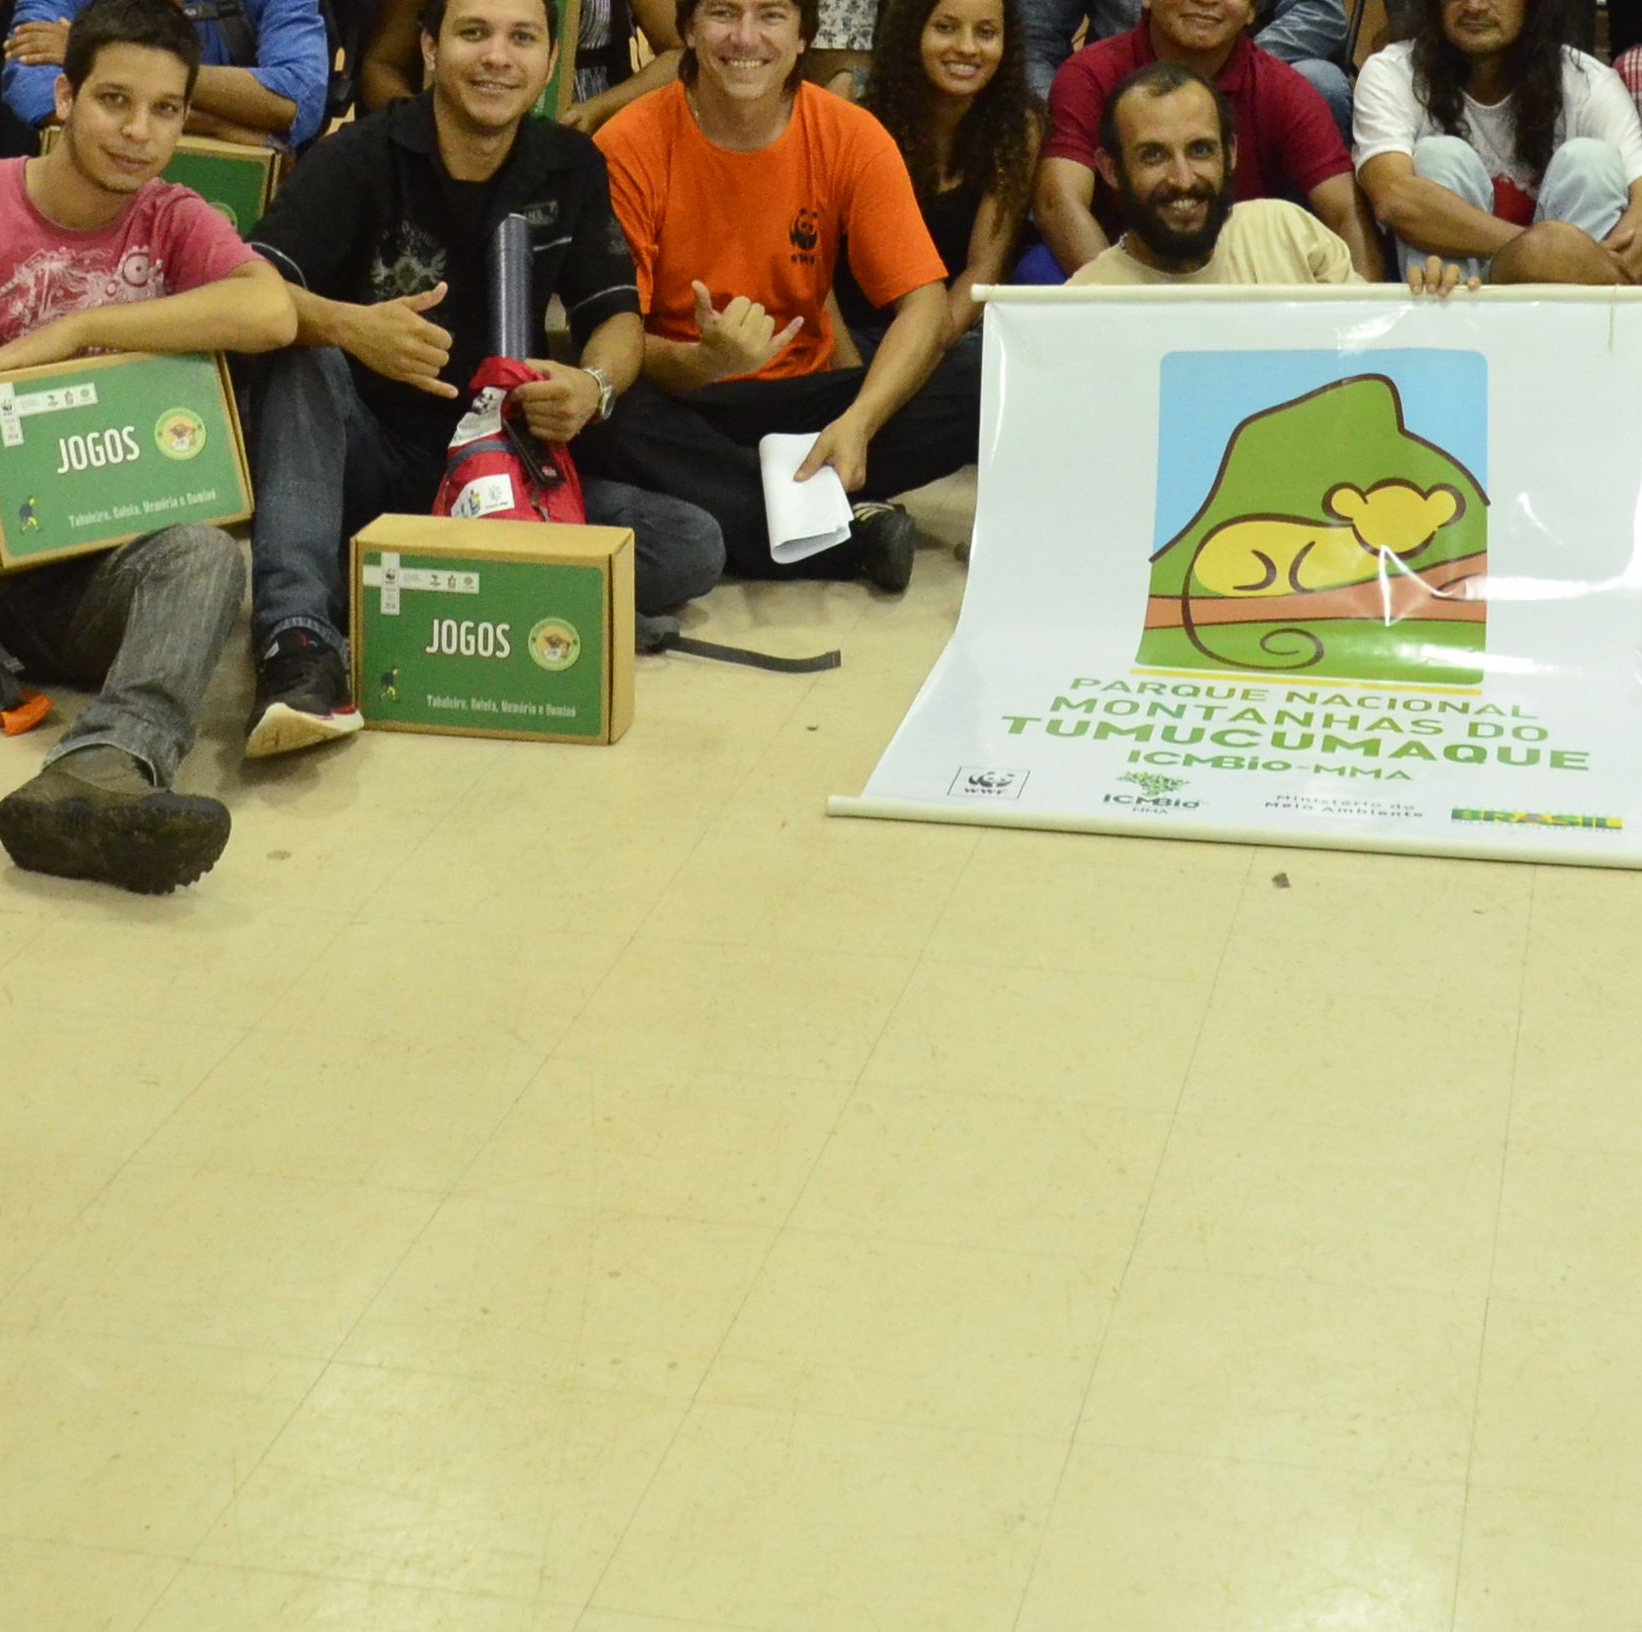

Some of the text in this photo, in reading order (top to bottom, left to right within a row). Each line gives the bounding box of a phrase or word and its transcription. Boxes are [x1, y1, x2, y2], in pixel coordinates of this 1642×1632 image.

[57, 425, 140, 474] JOGOS
[425, 618, 511, 659] JOGOS
[1049, 695, 1549, 743] MONTANHAS DO
[1070, 677, 1538, 719] PARQUE NACIONAL
[1001, 715, 1591, 771] TUMUCUMAQUE
[1126, 750, 1413, 781] ICMBio-MMA
[1101, 793, 1201, 810] ICMBio
